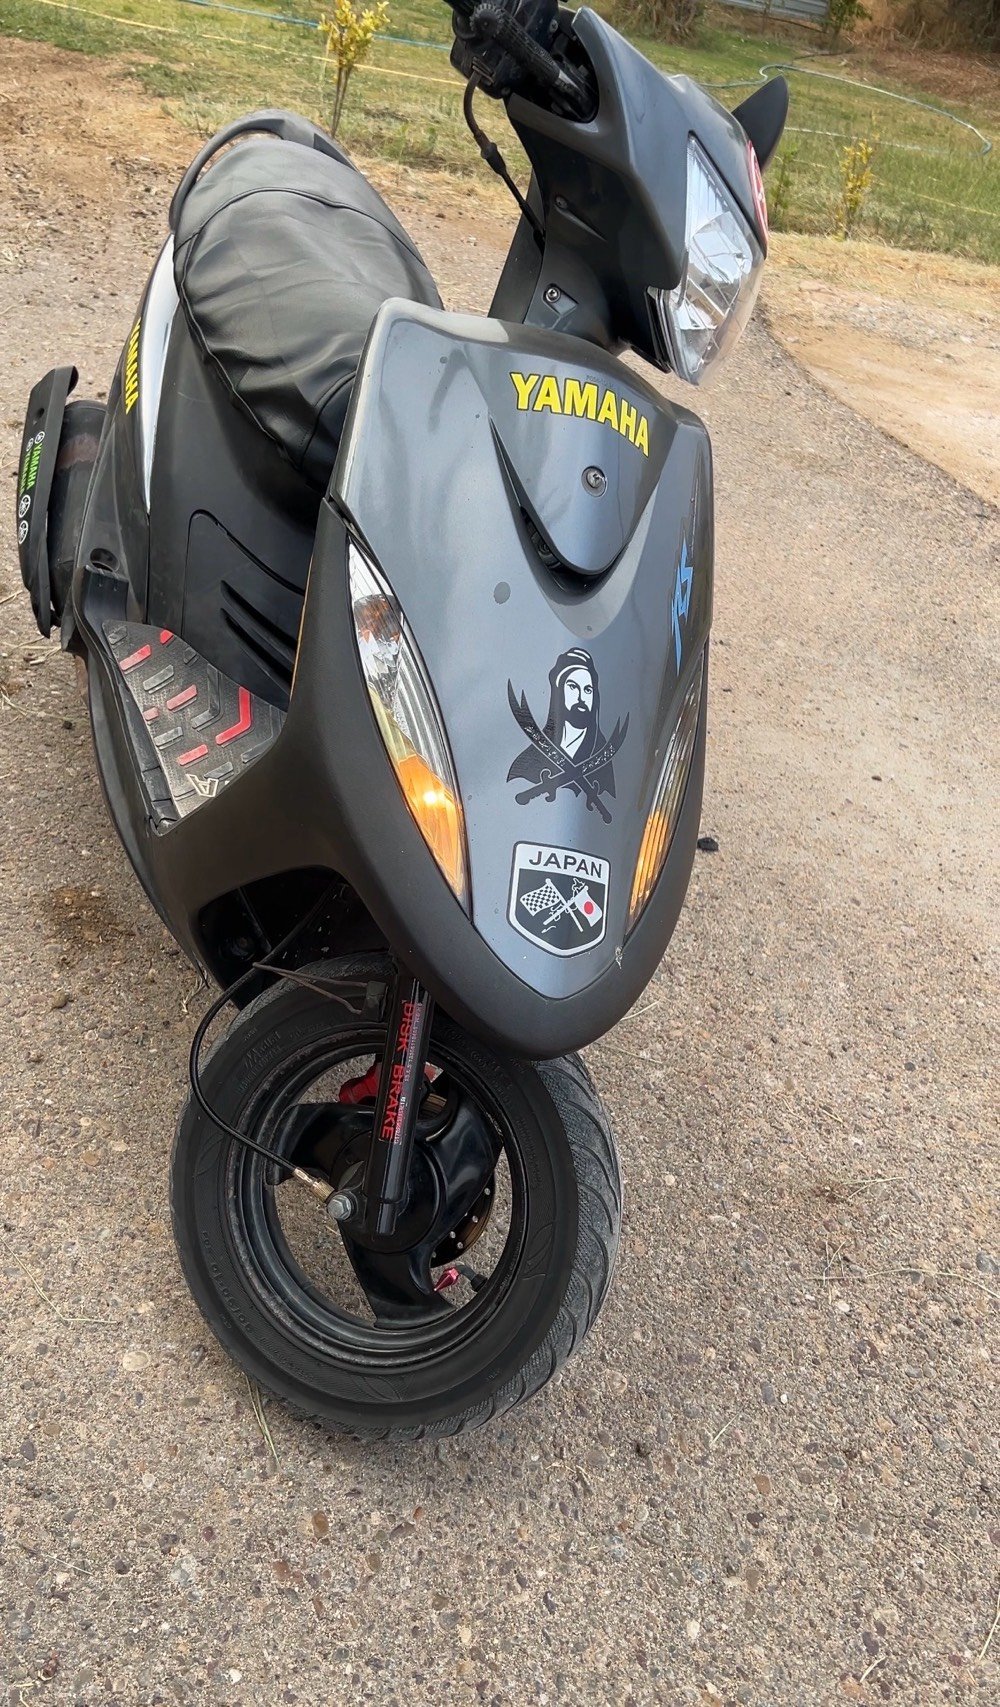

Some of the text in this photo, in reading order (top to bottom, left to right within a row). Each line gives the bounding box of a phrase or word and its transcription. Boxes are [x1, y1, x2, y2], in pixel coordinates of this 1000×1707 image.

[125, 317, 141, 415] YAMAHA
[509, 372, 649, 458] YAMAHA
[26, 442, 43, 490] YAMAHA
[528, 850, 602, 879] JAPAN
[397, 1002, 416, 1053] DISK
[381, 1064, 406, 1140] BRAKE
